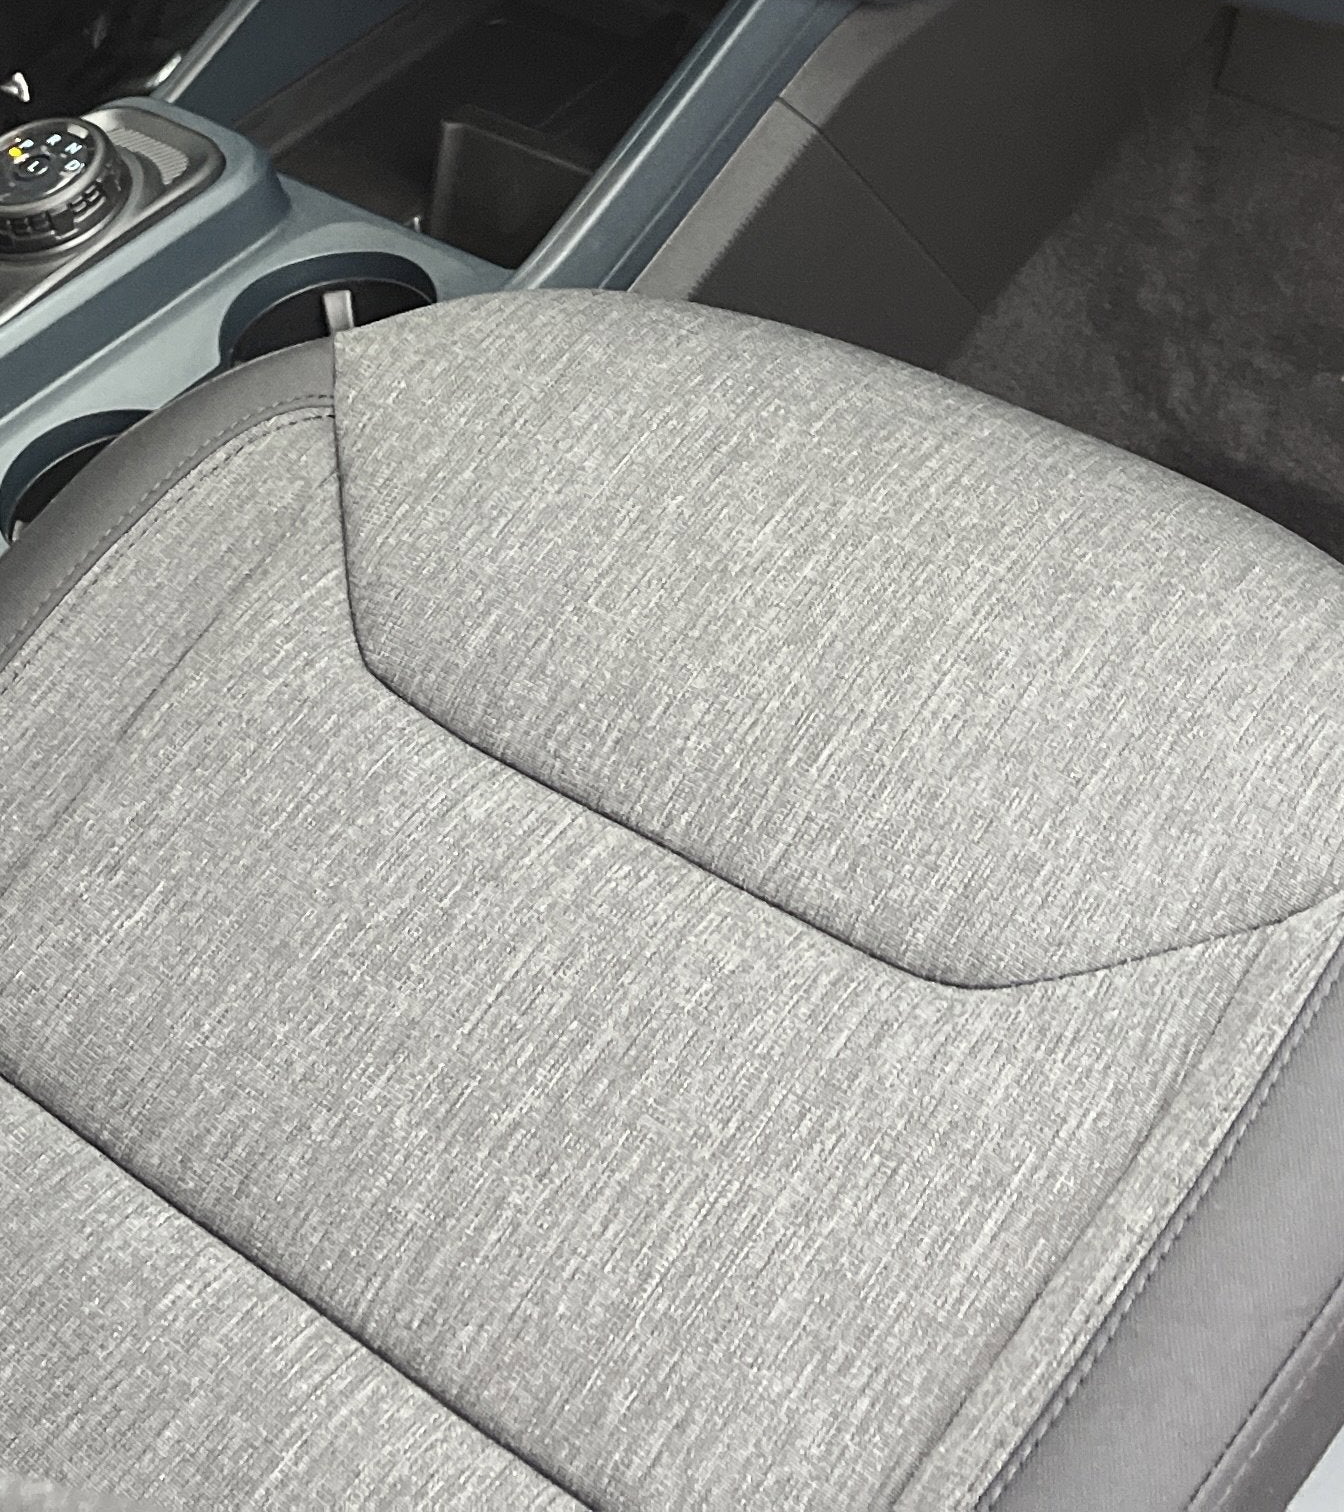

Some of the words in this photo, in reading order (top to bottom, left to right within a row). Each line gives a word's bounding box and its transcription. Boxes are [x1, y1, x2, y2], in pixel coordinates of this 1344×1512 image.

[46, 133, 62, 146] R
[64, 142, 82, 155] N
[64, 159, 81, 171] D
